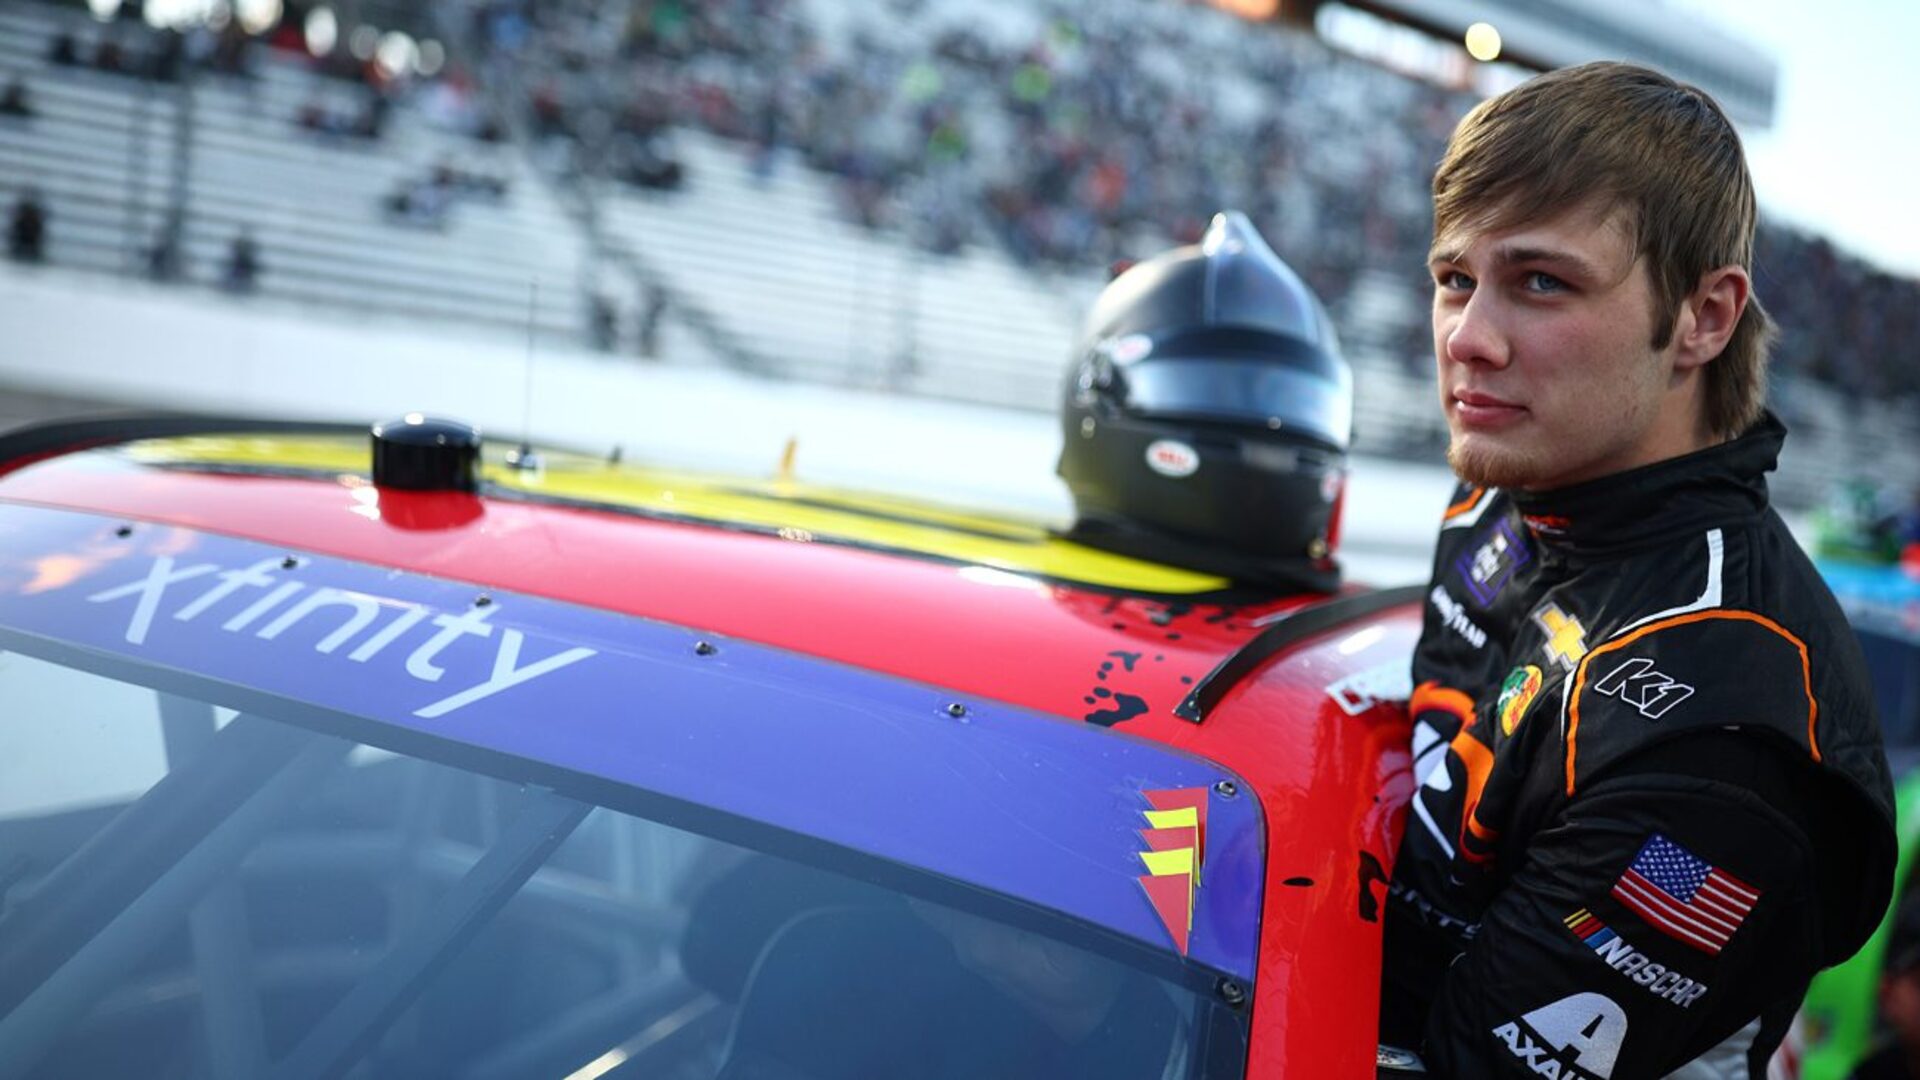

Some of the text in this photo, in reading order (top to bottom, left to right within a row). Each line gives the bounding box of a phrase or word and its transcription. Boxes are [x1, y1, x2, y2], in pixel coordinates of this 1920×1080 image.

[88, 556, 598, 719] xfinity
[1594, 658, 1694, 719] K1
[1595, 935, 1708, 1009] NASCAR
[1492, 1021, 1586, 1080] AXA
